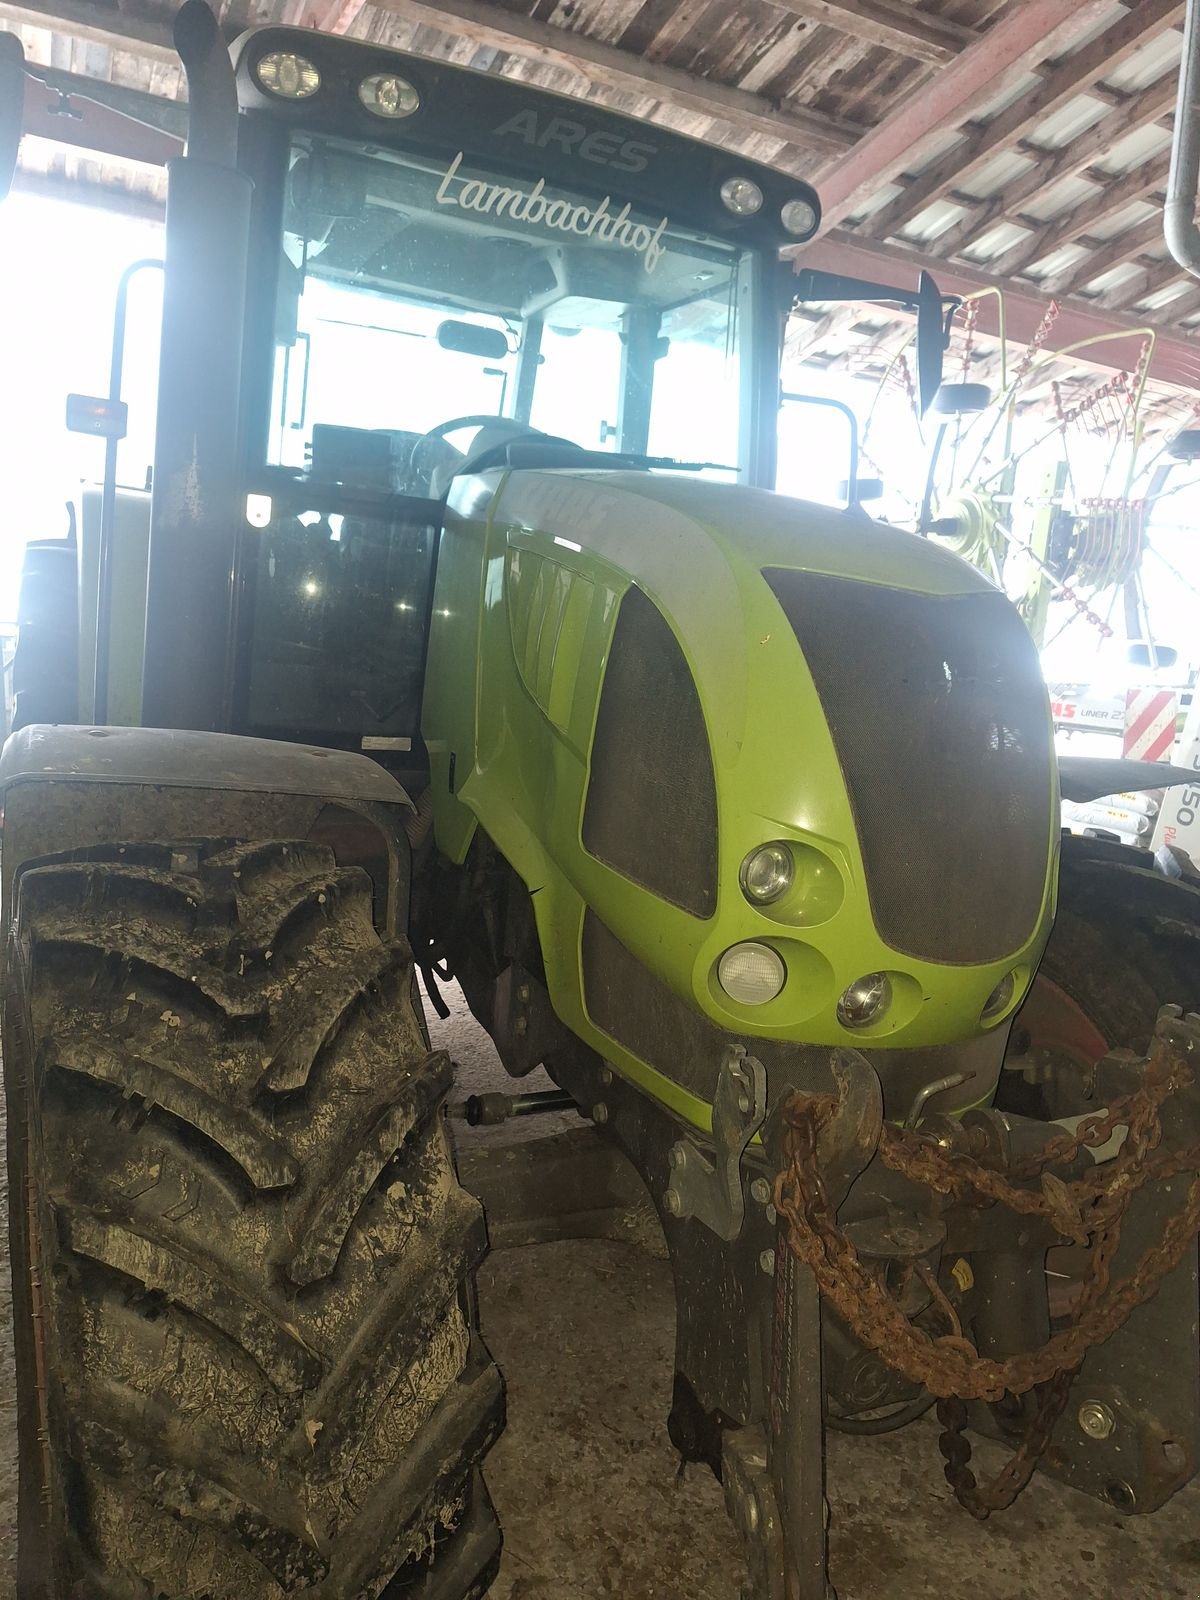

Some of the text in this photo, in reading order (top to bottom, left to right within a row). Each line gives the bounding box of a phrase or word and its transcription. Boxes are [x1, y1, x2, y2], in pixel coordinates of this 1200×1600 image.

[492, 109, 657, 172] ARES
[436, 151, 668, 274] Lambachhof
[1081, 709, 1108, 719] LINER
